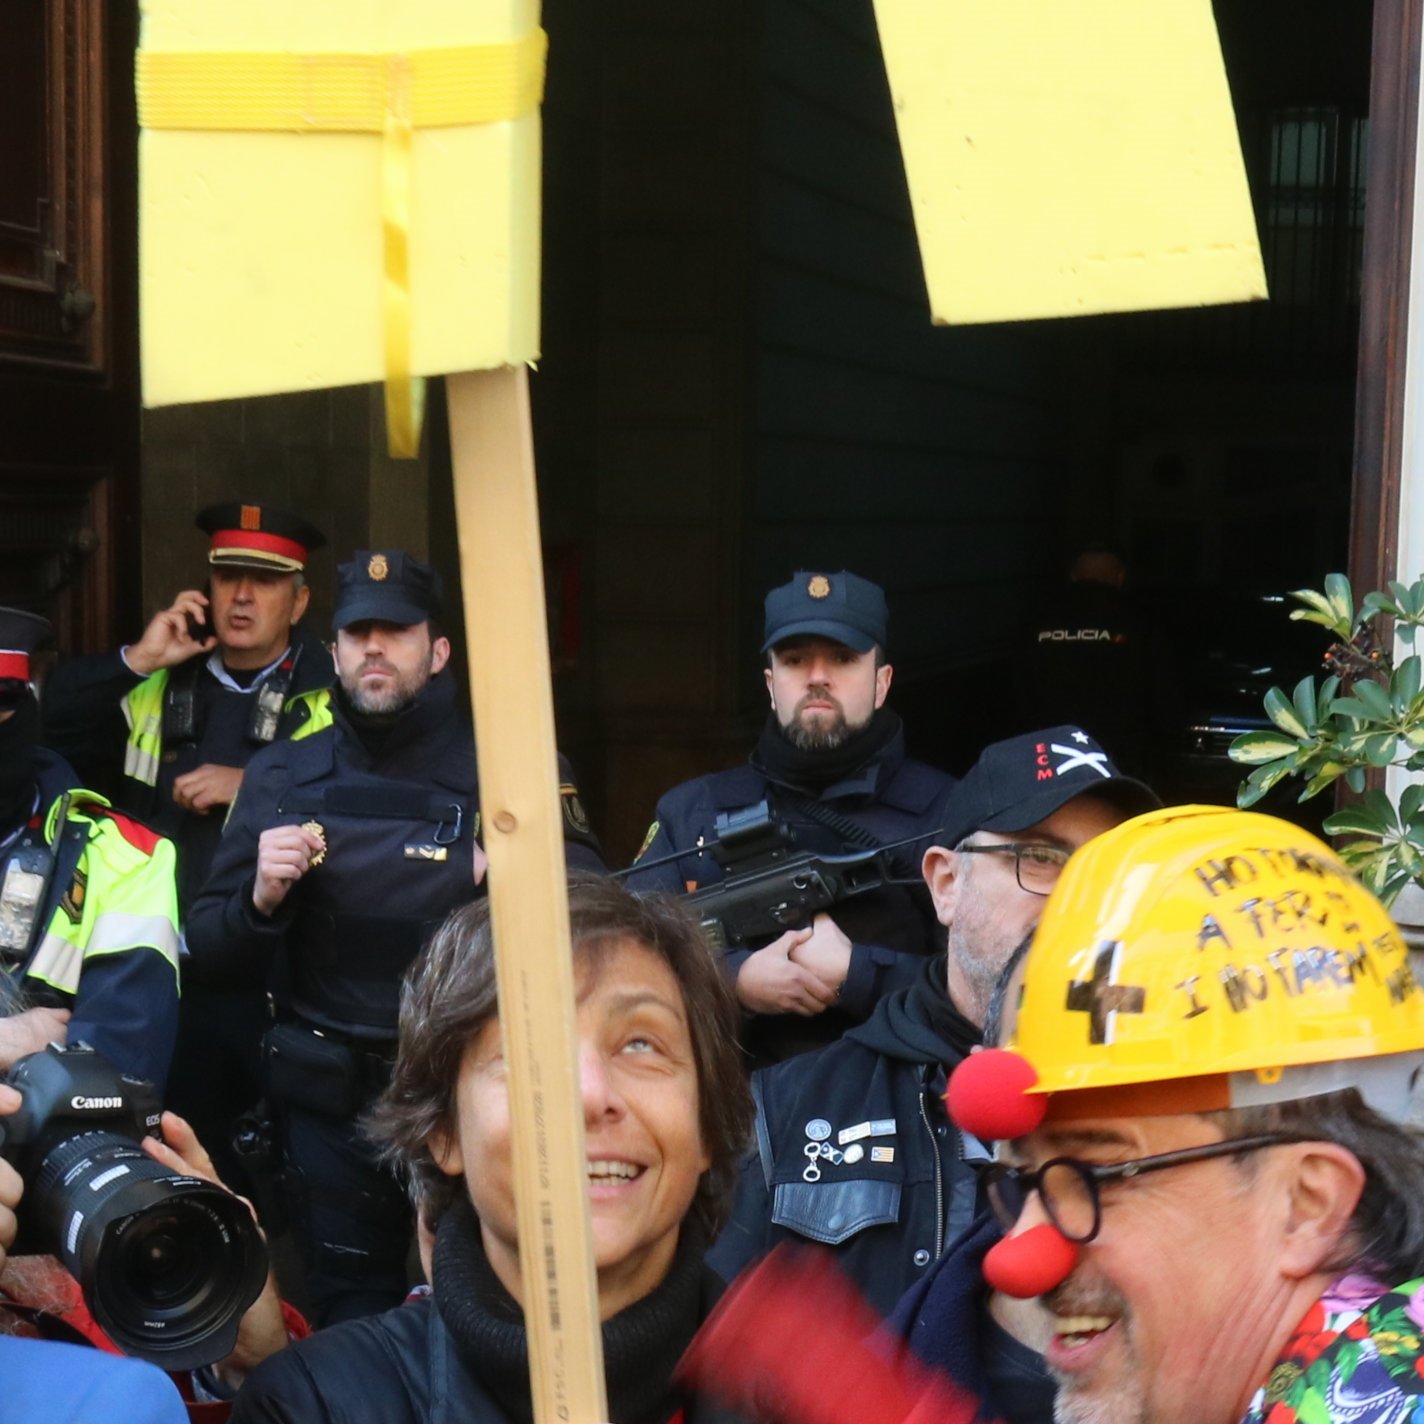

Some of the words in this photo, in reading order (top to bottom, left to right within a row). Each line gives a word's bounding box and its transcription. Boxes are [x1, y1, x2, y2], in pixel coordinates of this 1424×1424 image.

[1038, 629, 1111, 643] POLICIA
[1196, 912, 1233, 952] A
[1175, 976, 1209, 1019] I
[71, 1096, 123, 1110] Canon
[145, 1113, 161, 1127] EOS
